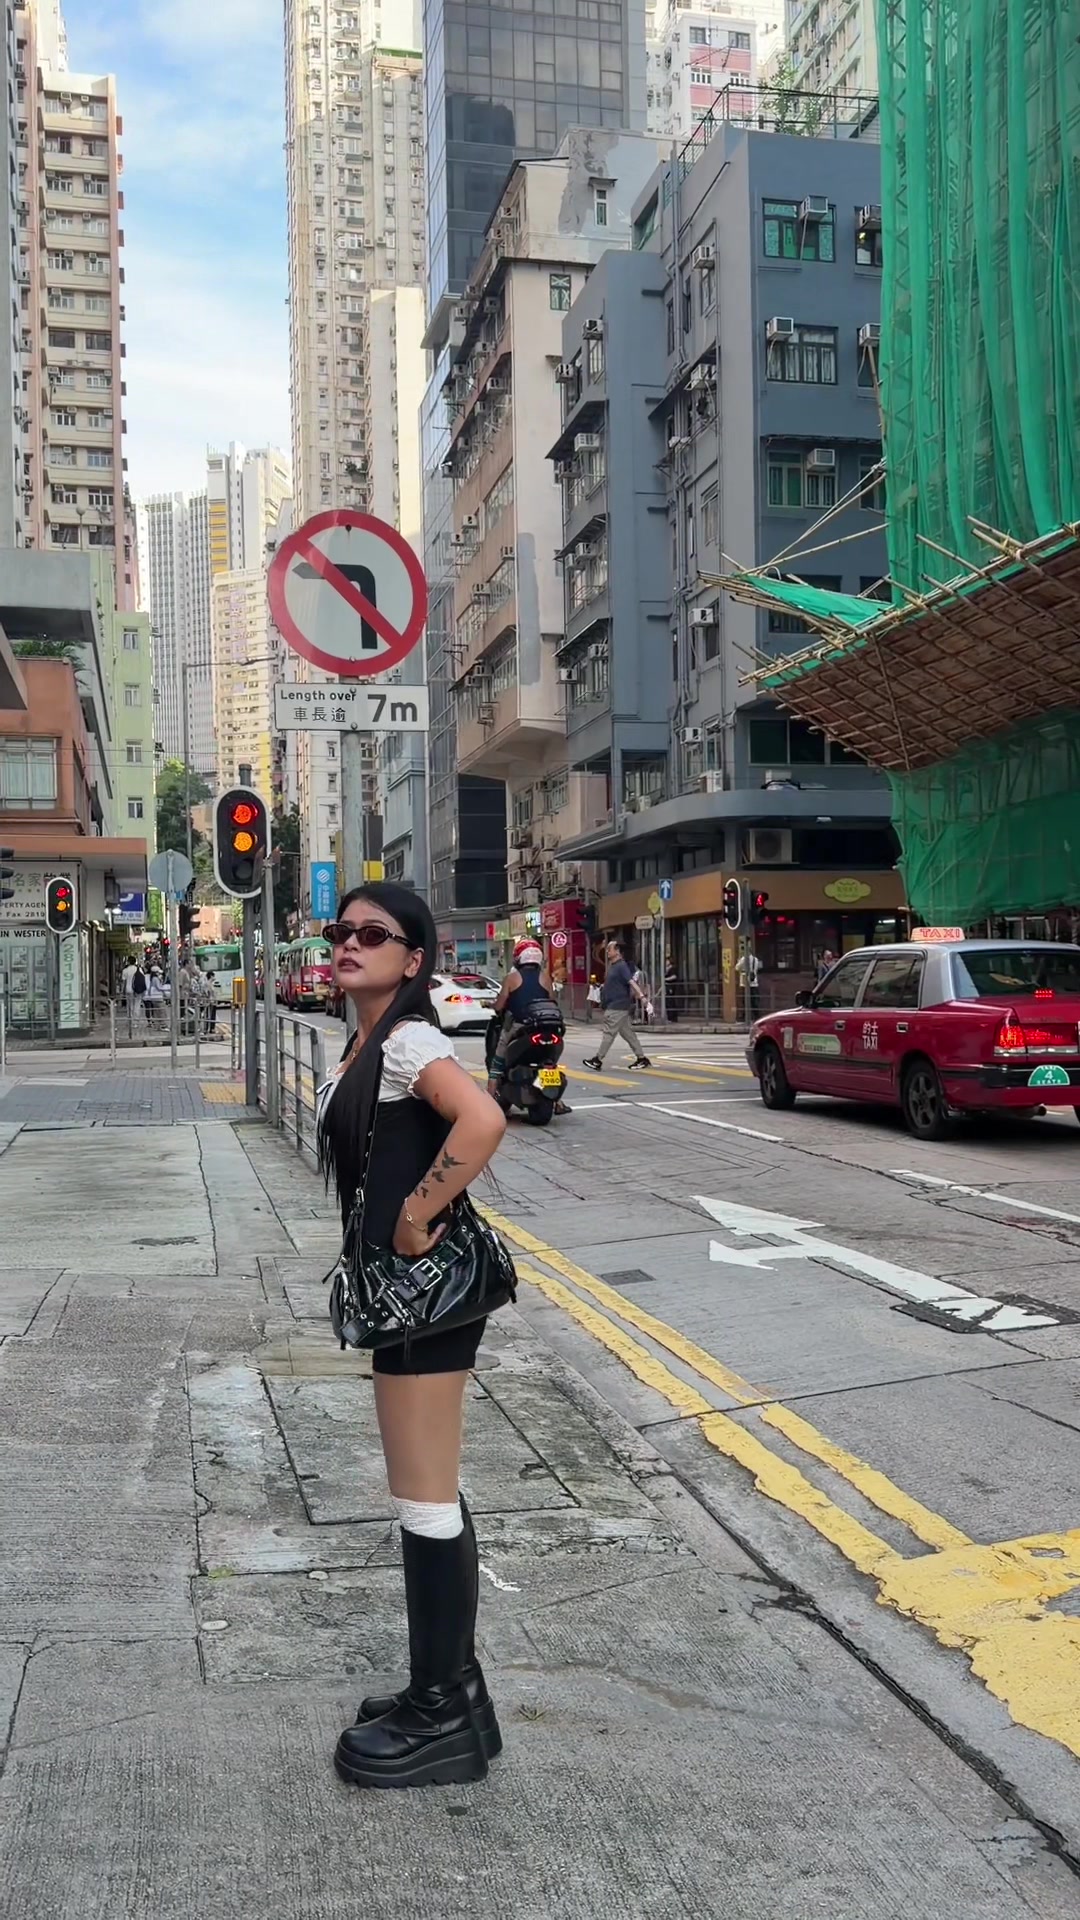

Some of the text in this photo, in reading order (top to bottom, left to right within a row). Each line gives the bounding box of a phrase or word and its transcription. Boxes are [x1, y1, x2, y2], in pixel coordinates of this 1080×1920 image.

[280, 690, 356, 701] Length over
[294, 708, 348, 722] 車長逾
[368, 694, 417, 722] 7m
[920, 928, 960, 938] TAXI
[863, 1021, 878, 1035] 的士
[862, 1036, 878, 1050] TAXI
[1044, 1070, 1054, 1079] 4
